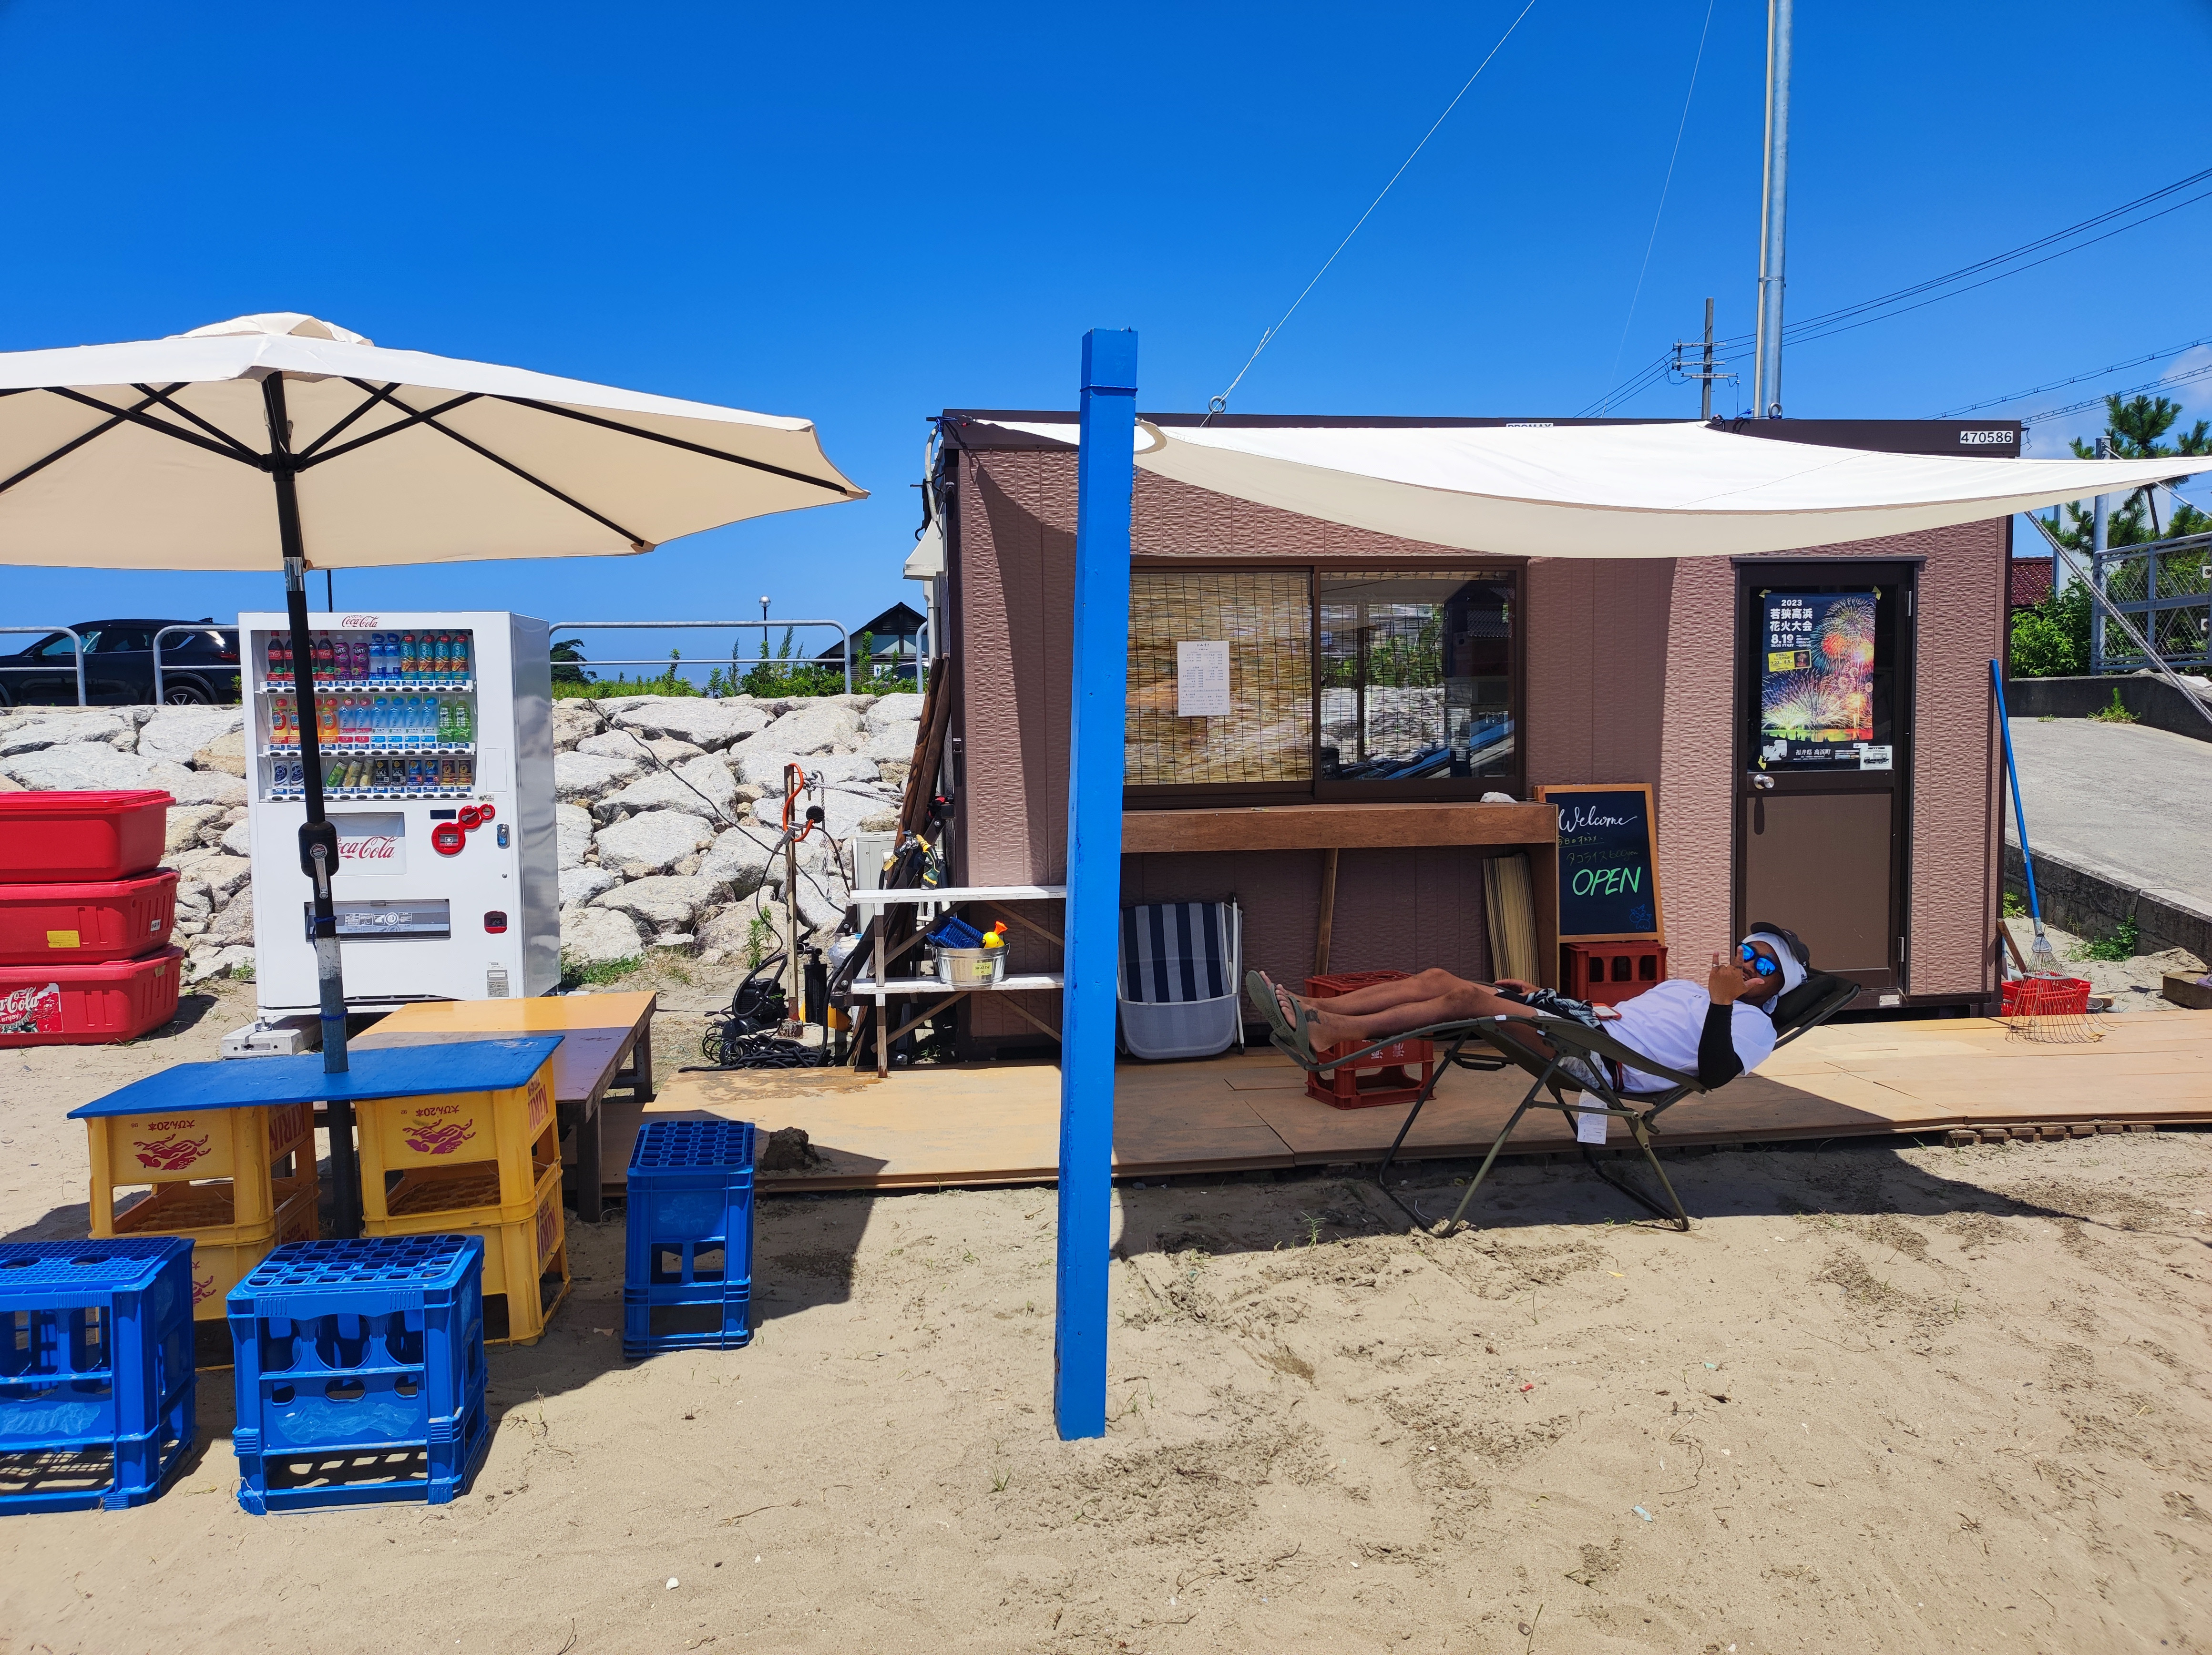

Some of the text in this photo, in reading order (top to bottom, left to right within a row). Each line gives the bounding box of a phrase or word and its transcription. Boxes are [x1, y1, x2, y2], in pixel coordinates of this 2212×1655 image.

[1961, 432, 2012, 442] 470586
[1770, 608, 1813, 619] 若狭高浜
[342, 616, 379, 627] Coca-Cola
[1770, 621, 1813, 632] 花火大会
[1558, 806, 1638, 833] Welcome
[1573, 867, 1641, 896] OPEN
[416, 1104, 460, 1117] 大びん20本
[148, 1120, 195, 1131] 大びん20本
